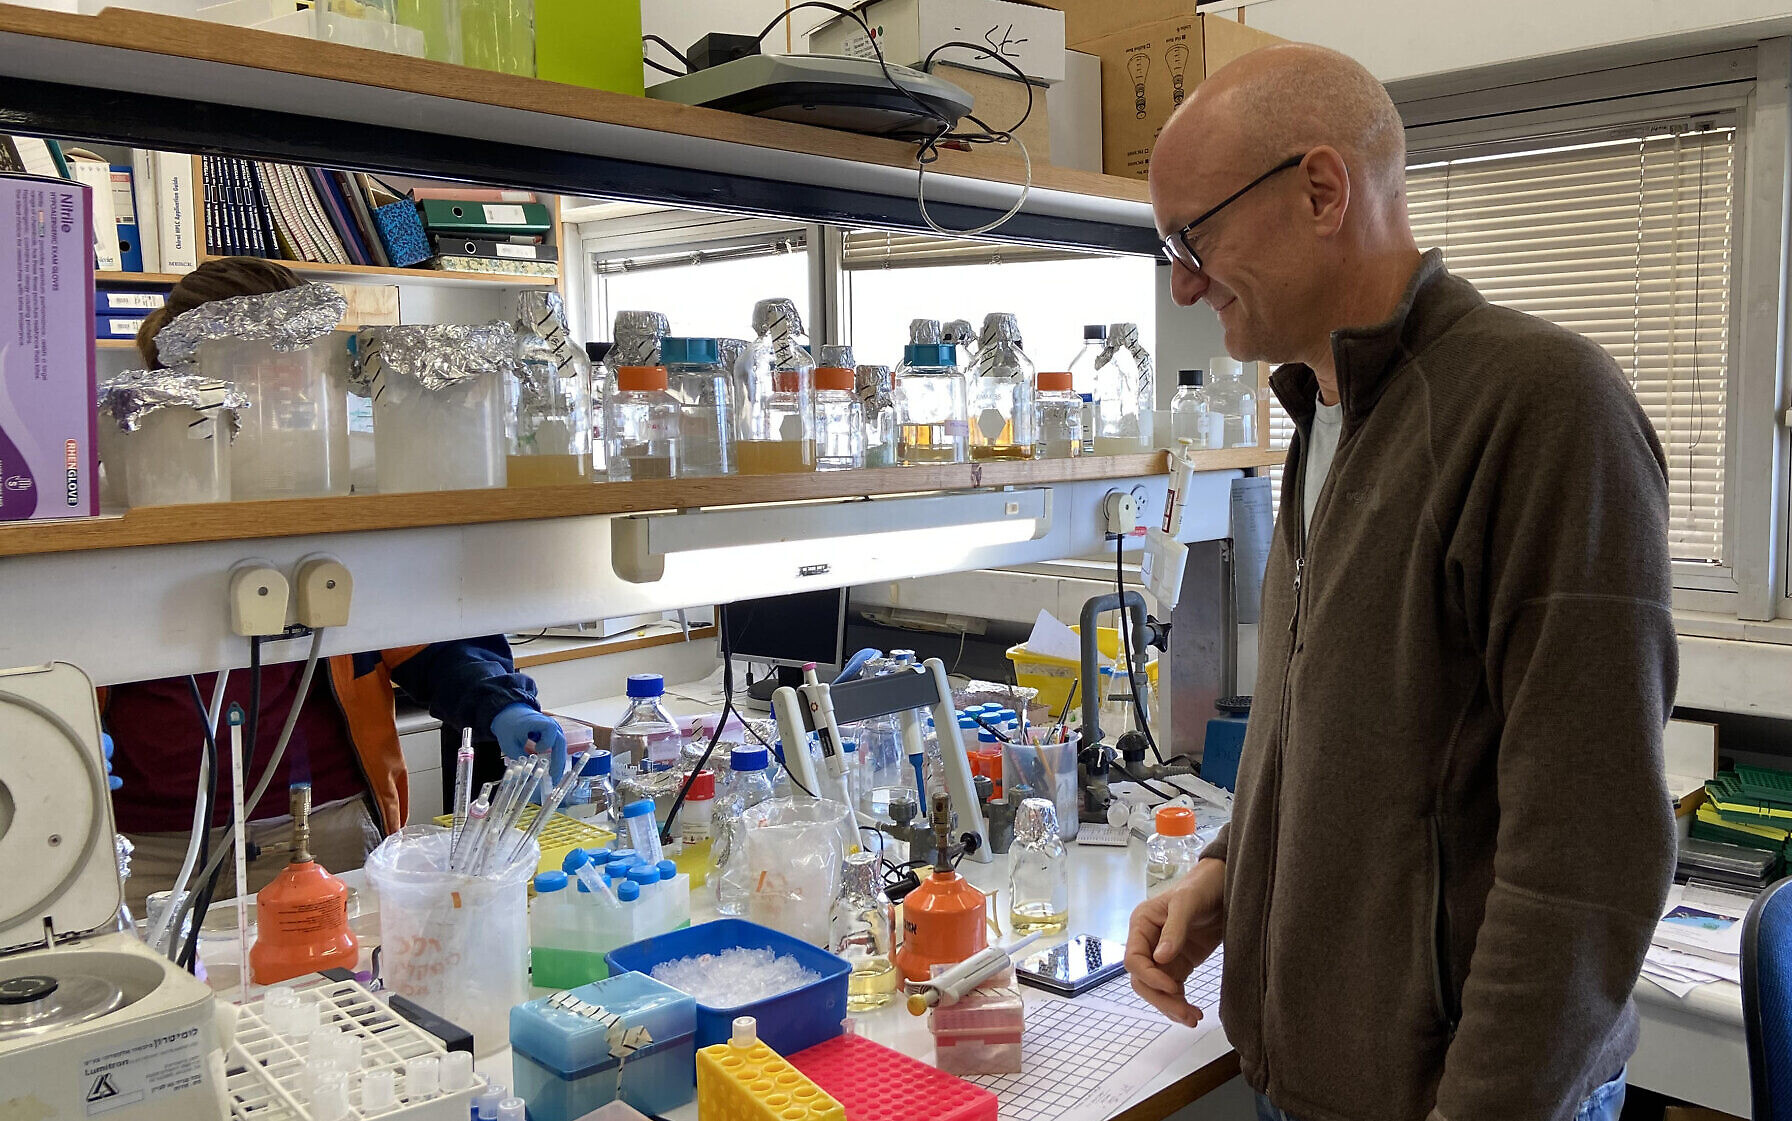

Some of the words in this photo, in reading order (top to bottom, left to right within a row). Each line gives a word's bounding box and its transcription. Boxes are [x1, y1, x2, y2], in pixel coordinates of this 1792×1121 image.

[60, 193, 74, 233] Nitrile
[52, 266, 60, 291] GLOVES
[67, 442, 78, 503] RHENGLOVE
[85, 1059, 129, 1076] Lumitron
